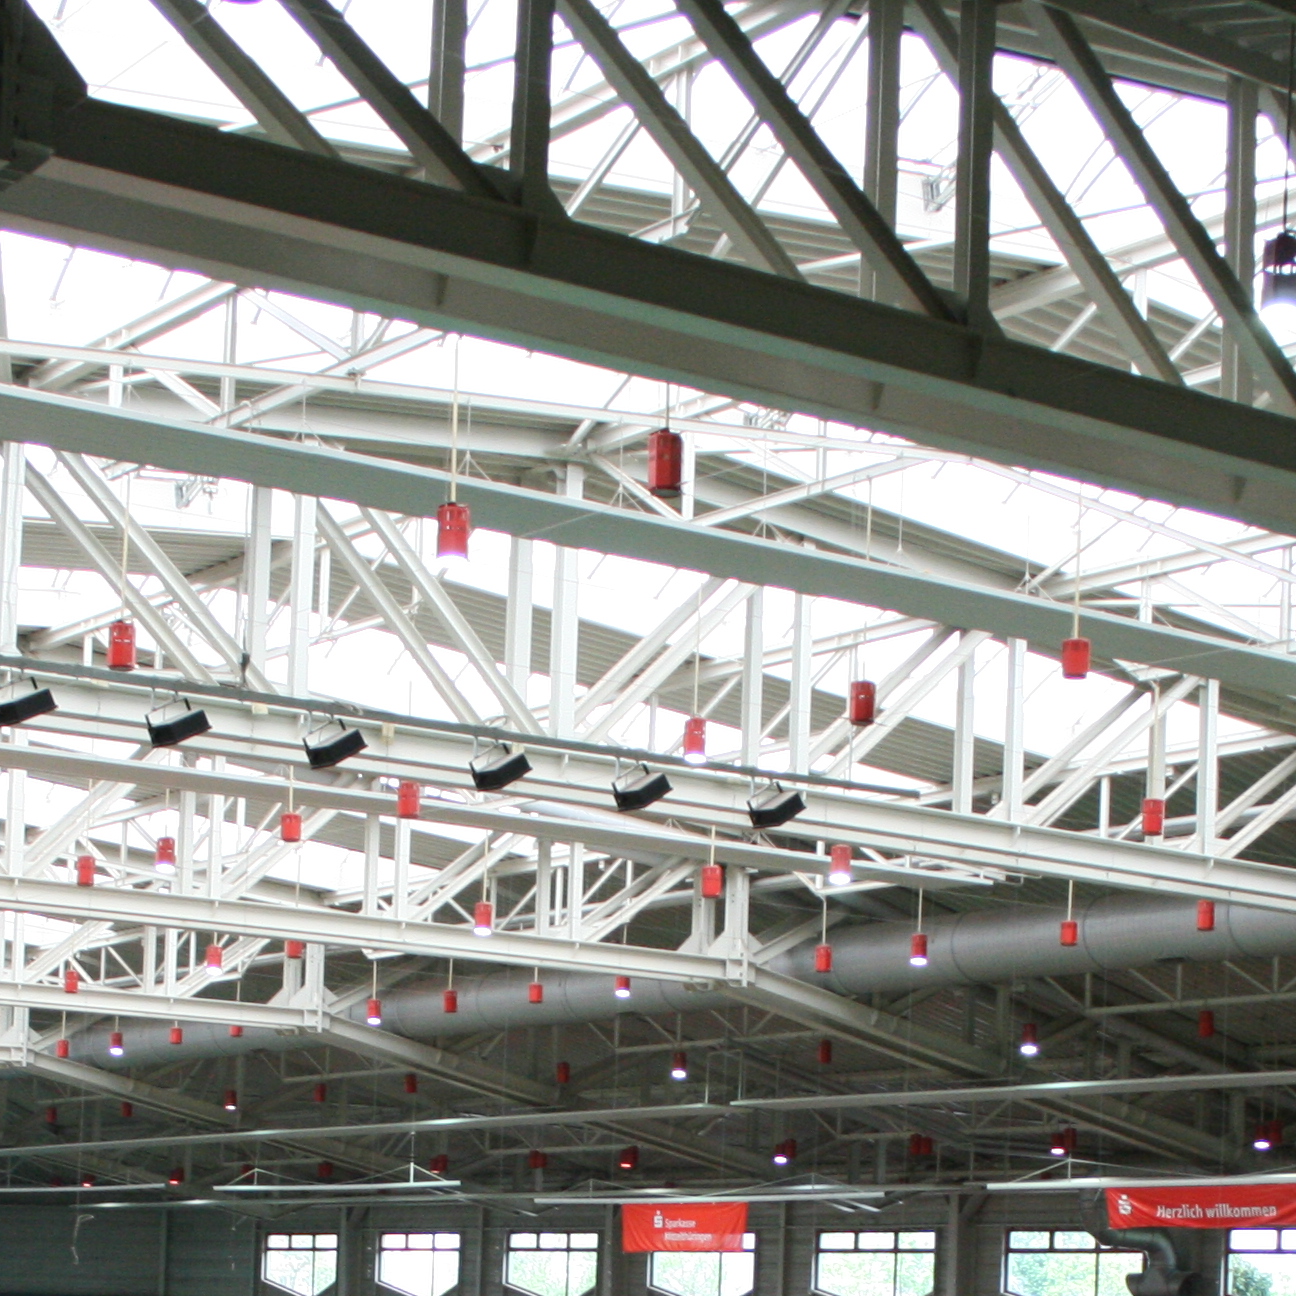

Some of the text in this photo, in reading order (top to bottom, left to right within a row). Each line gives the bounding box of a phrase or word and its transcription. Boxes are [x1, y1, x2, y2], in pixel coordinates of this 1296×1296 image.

[1156, 1204, 1203, 1218] Herzlich
[1205, 1203, 1278, 1218] willkommen
[664, 1218, 697, 1230] Sparkasse
